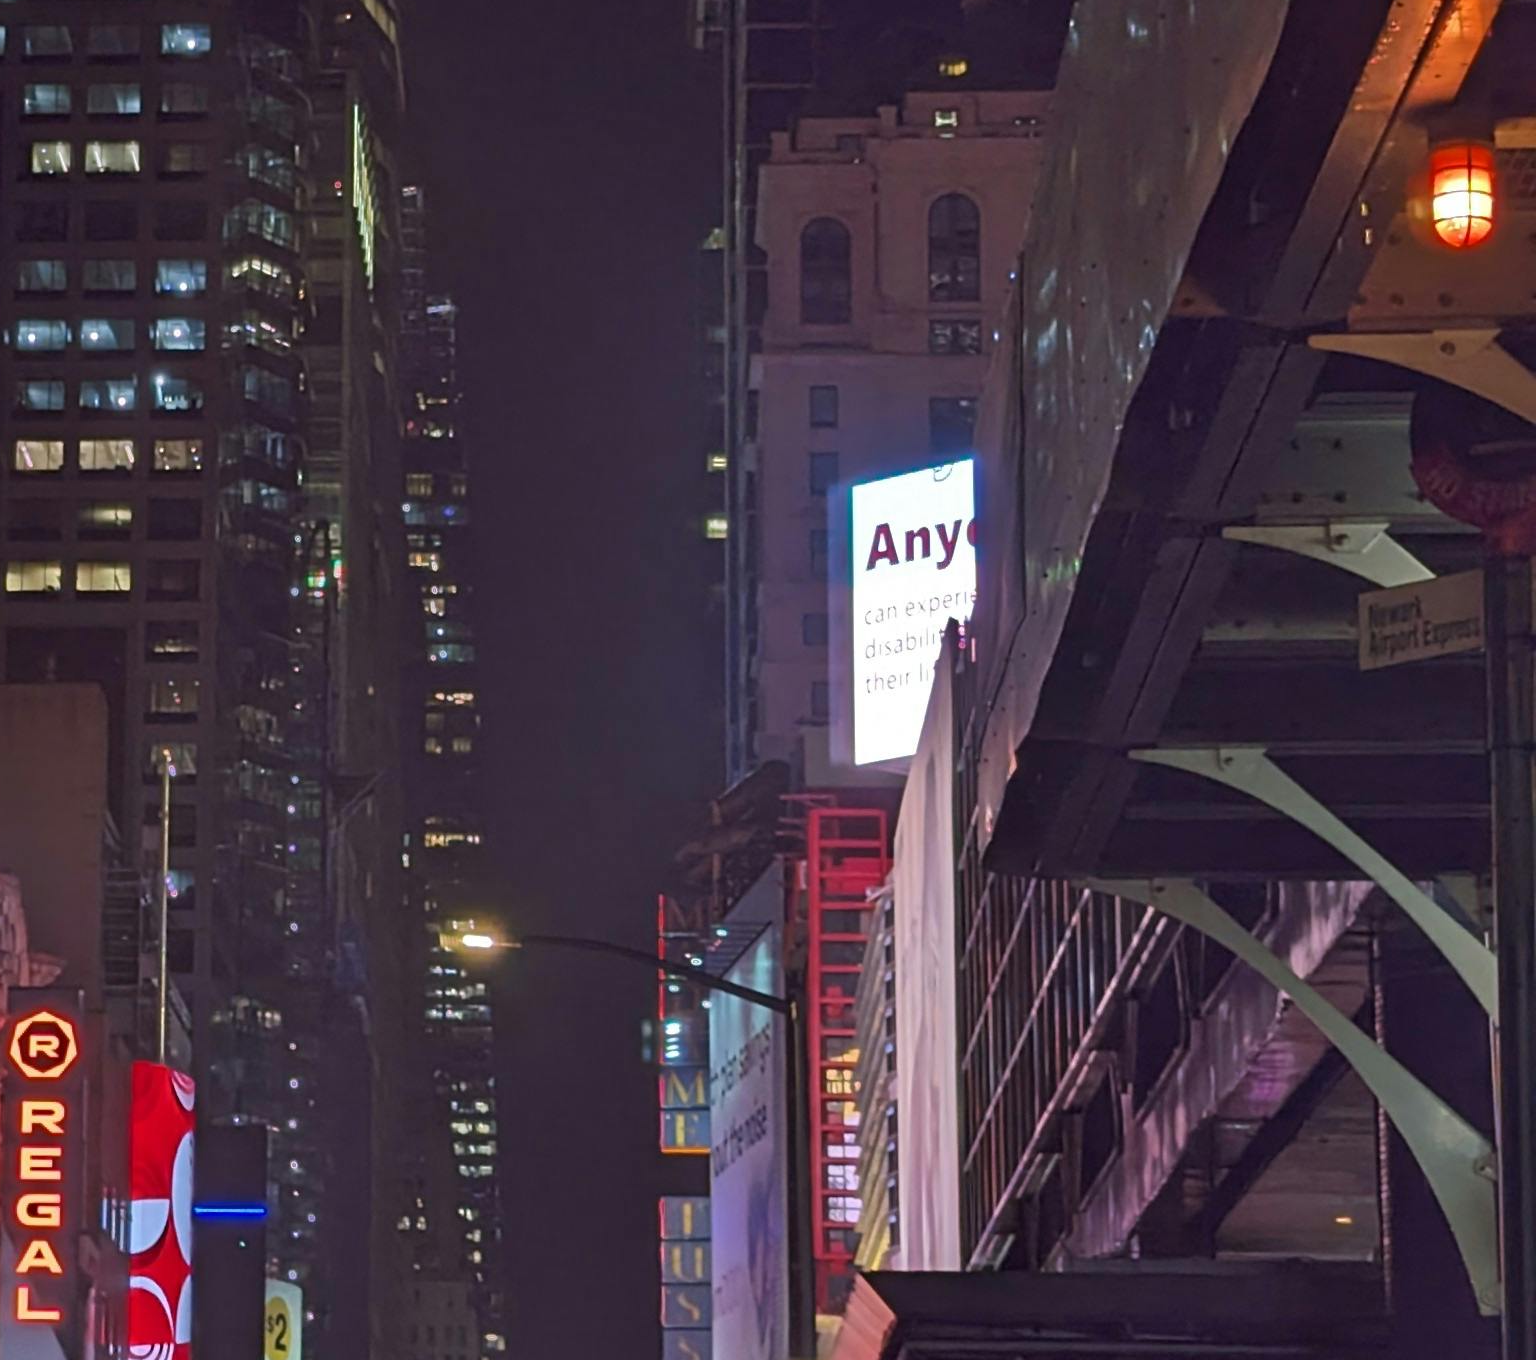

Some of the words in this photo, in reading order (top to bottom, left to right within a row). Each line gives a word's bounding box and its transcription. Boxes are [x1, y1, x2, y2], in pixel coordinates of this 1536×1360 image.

[863, 605, 898, 626] can
[1368, 596, 1422, 630] Newark
[1368, 624, 1421, 660] Airport
[1423, 617, 1482, 649] Express
[865, 671, 912, 695] their
[28, 1034, 60, 1059] R
[743, 1095, 768, 1150] noise
[15, 1100, 66, 1321] REGAL
